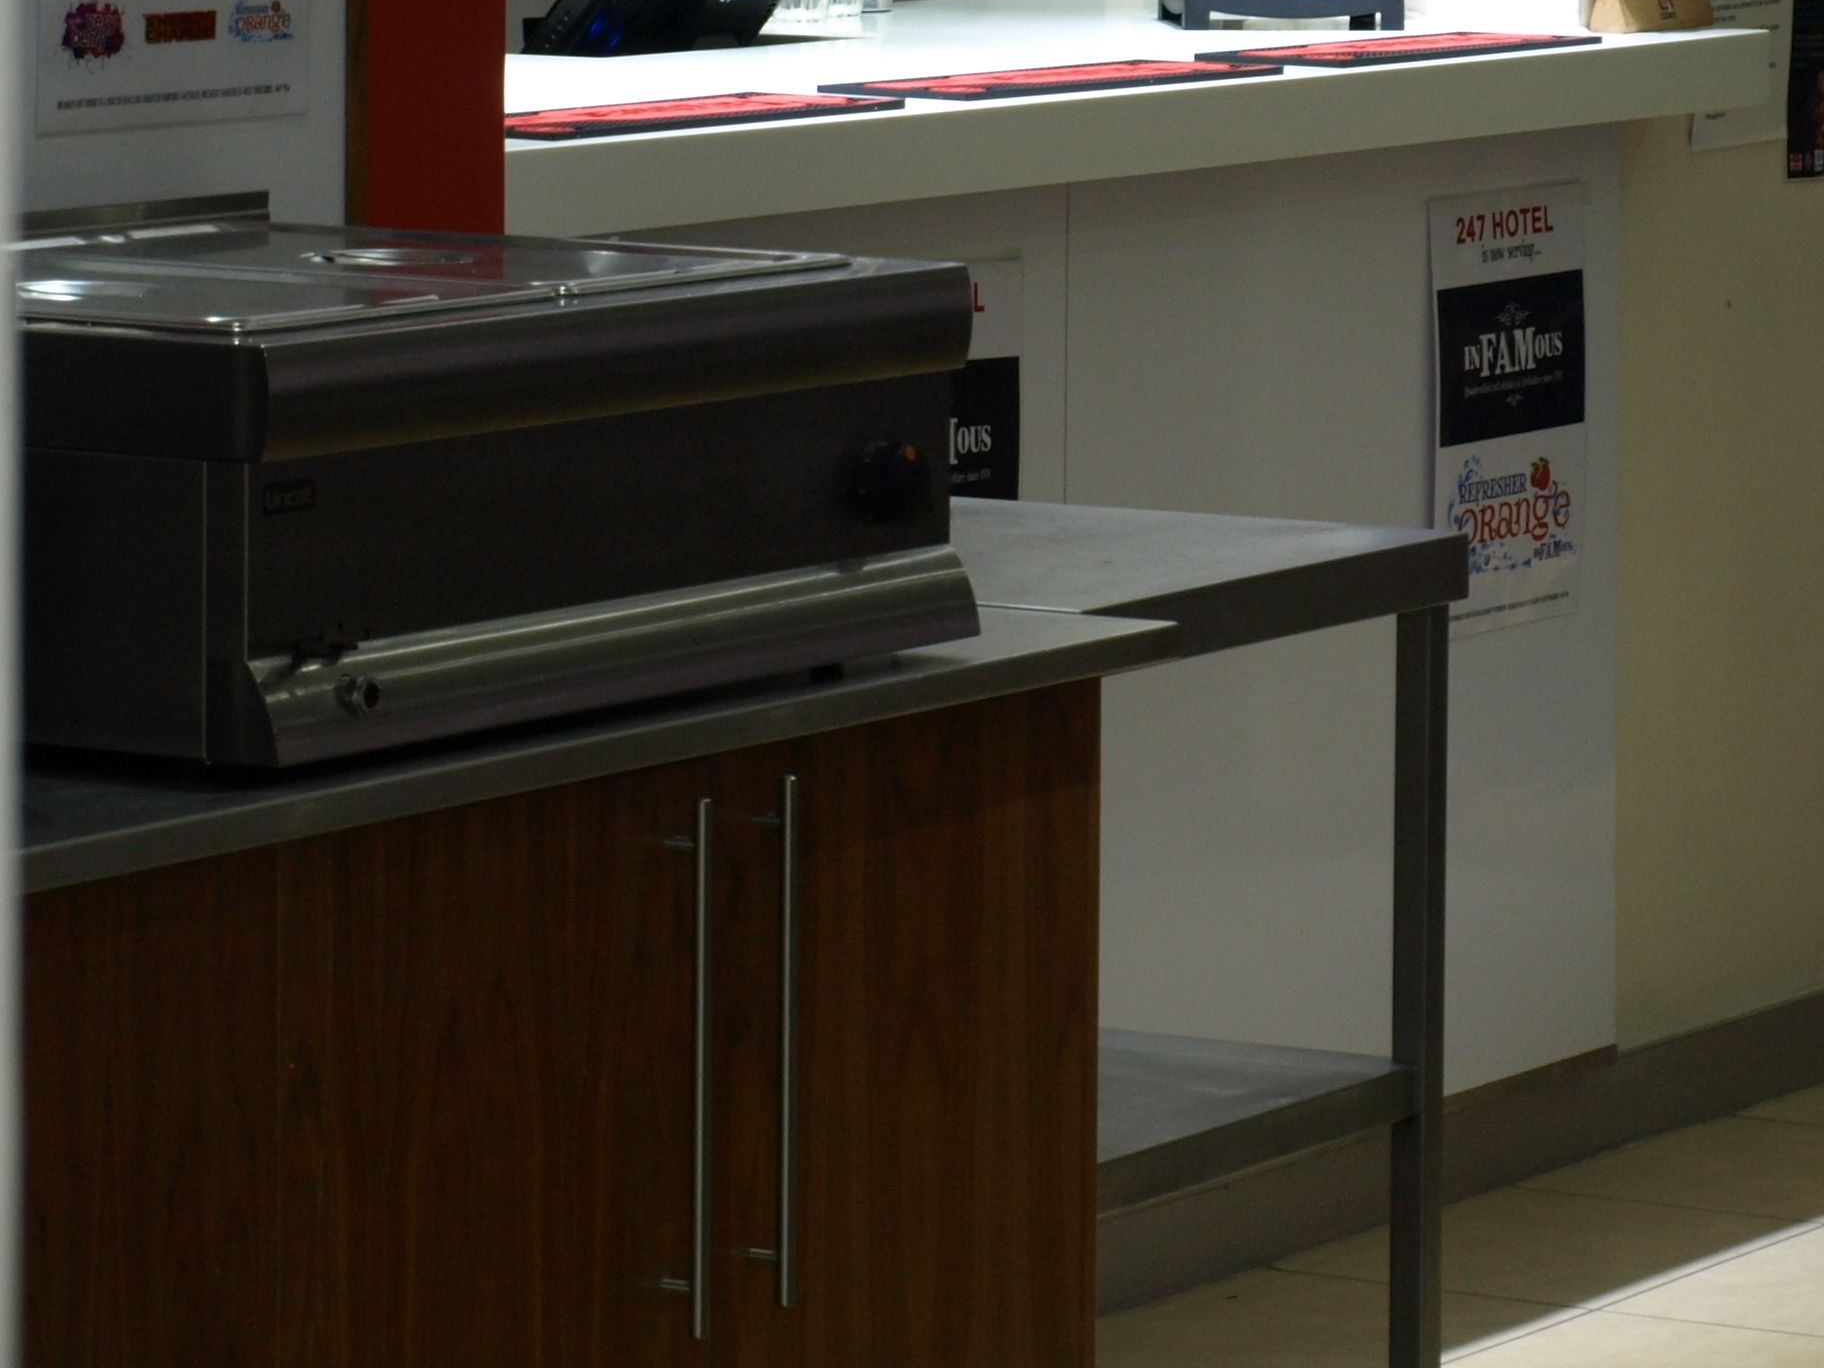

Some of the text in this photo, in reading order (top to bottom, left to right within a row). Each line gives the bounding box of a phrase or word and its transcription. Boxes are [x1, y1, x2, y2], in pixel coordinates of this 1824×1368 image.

[1456, 205, 1554, 244] 247 HOTEL
[1458, 472, 1528, 505] REFRESHER
